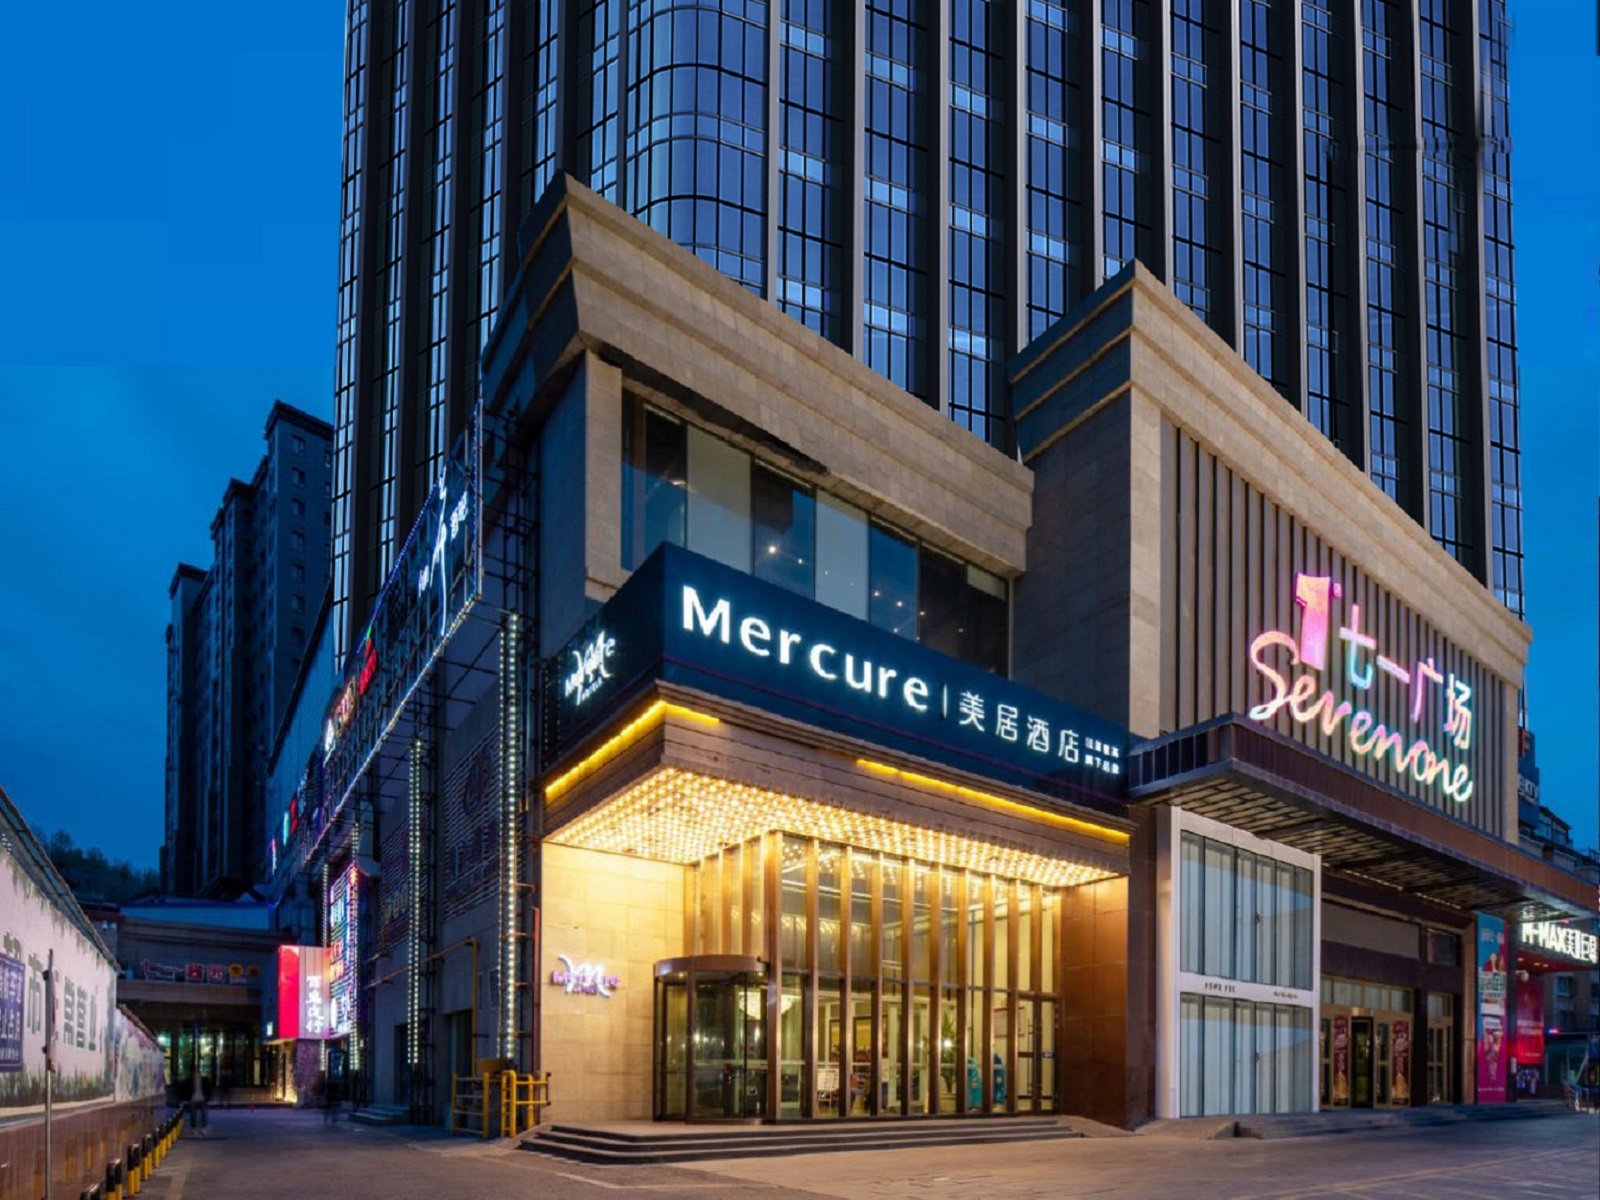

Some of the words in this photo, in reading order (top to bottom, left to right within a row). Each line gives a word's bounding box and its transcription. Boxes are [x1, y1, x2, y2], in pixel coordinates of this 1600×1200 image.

[682, 584, 930, 712] Mercure
[958, 690, 1080, 765] 美居酒店
[1250, 630, 1474, 802] Sevenone
[1339, 603, 1472, 750] 七一广场
